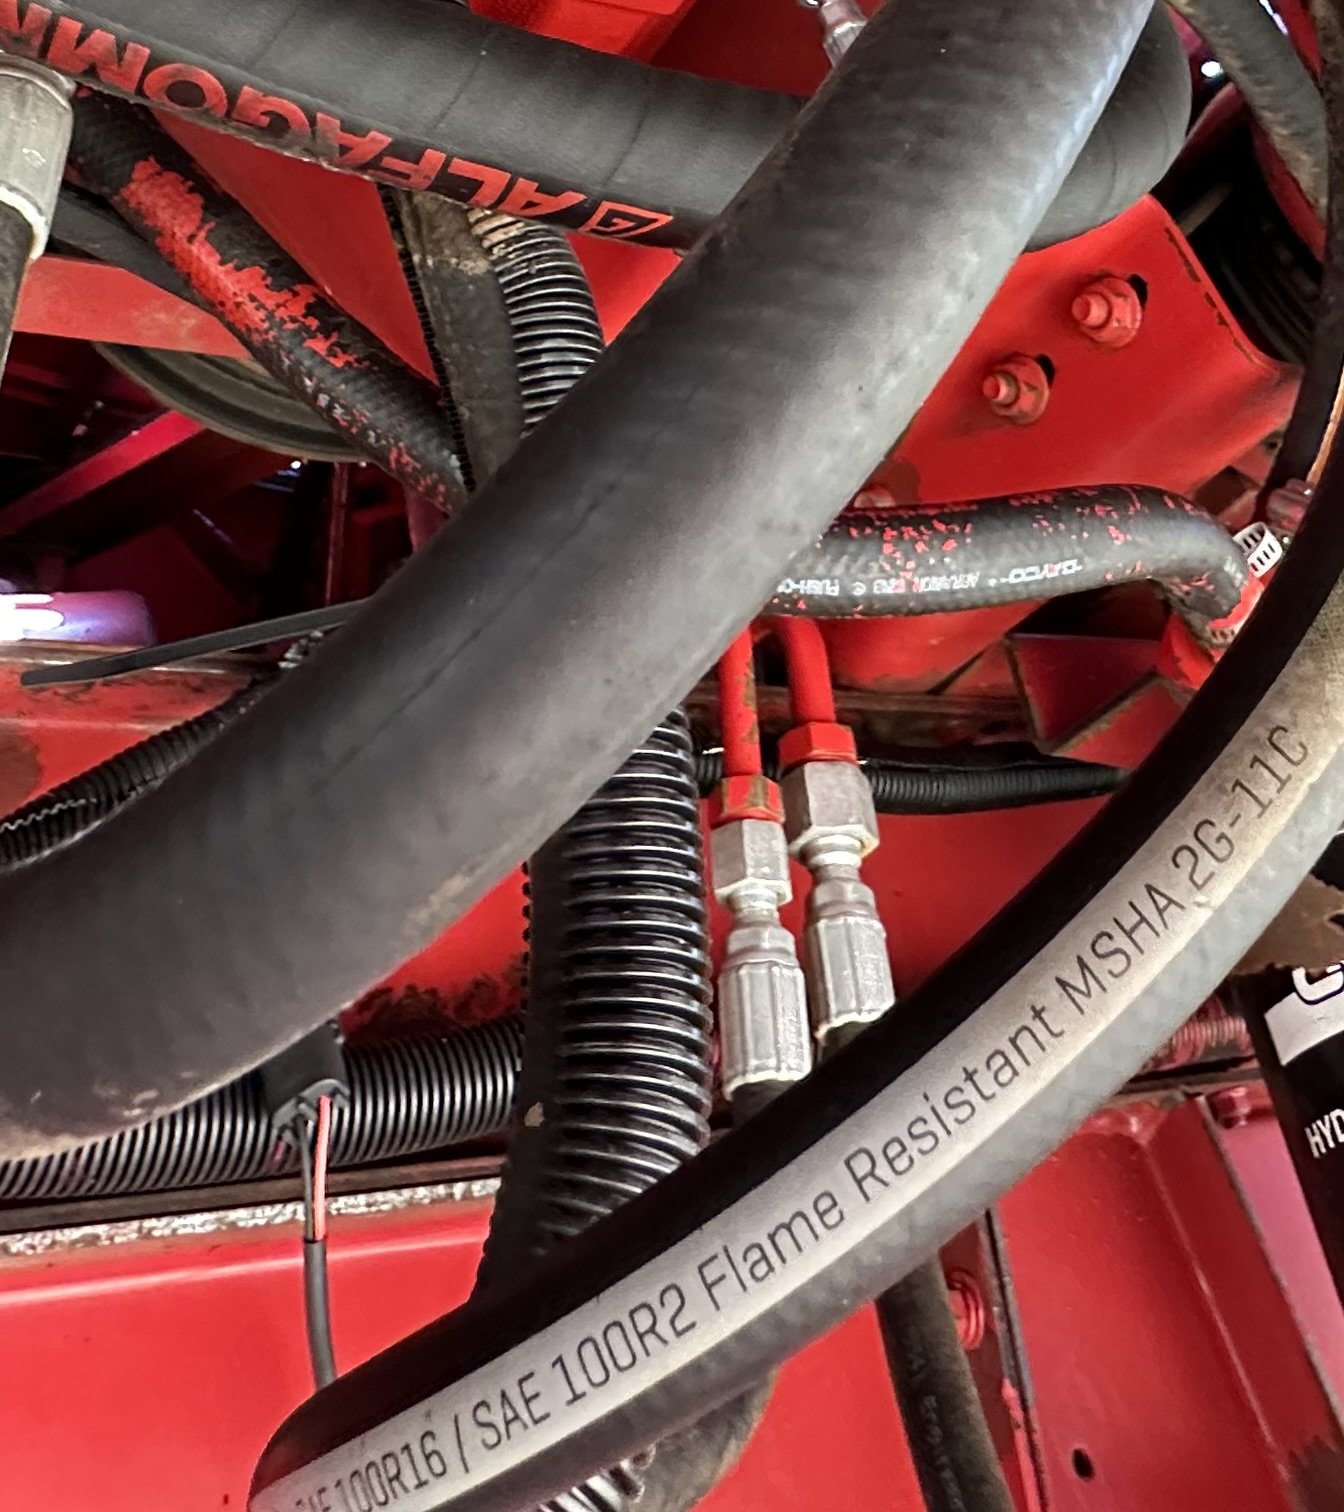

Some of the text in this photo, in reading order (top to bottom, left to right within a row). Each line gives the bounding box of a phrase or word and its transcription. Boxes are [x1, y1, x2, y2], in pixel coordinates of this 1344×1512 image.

[777, 577, 839, 597] PUSH-O
[454, 1414, 472, 1474] /
[470, 1372, 552, 1452] SAE
[551, 1284, 698, 1402] 100R2
[699, 1190, 845, 1313] Flame
[846, 1002, 1066, 1210] Resistant
[1061, 886, 1188, 1019] MSHA
[1172, 724, 1310, 888] 2G-11C
